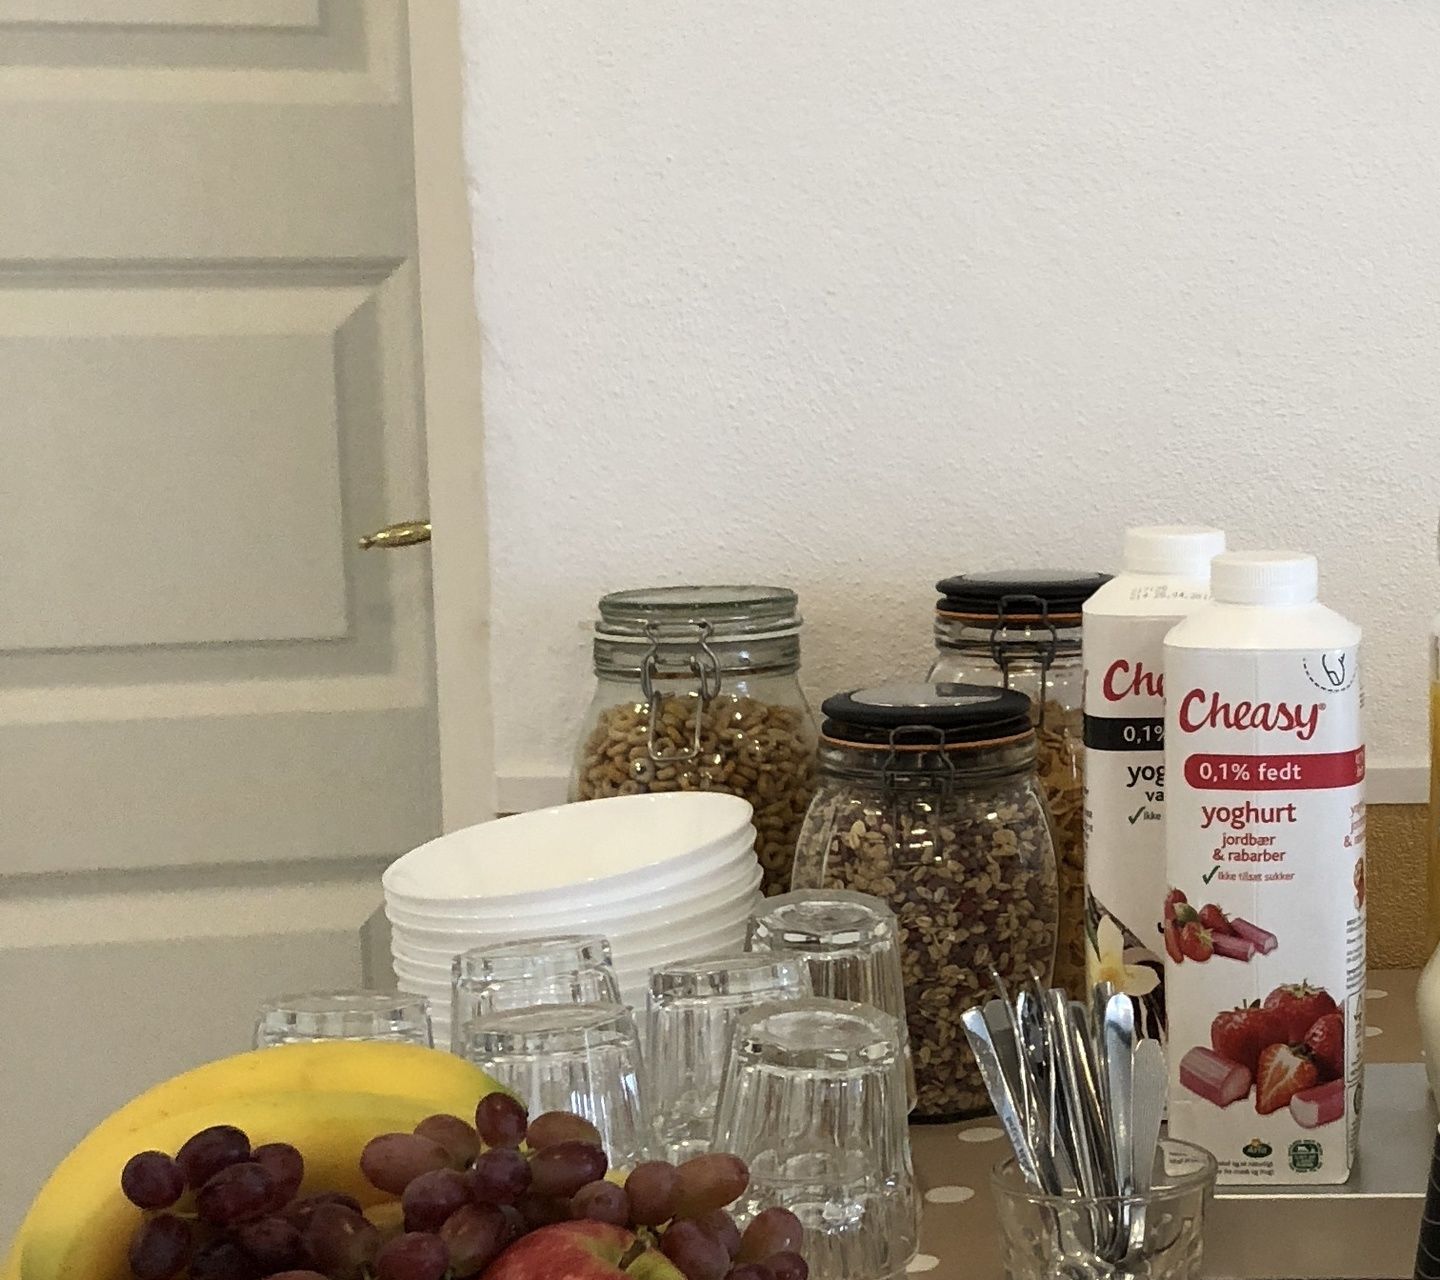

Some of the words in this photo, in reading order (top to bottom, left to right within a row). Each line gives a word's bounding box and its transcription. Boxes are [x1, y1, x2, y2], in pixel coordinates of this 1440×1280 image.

[1179, 688, 1321, 741] Cheasy
[1199, 762, 1250, 782] 0,1%
[1258, 762, 1302, 780] fedt
[1201, 801, 1297, 829] yoghurt
[1221, 833, 1276, 848] jordbær
[1212, 848, 1224, 861] &
[1228, 848, 1286, 862] rabarber
